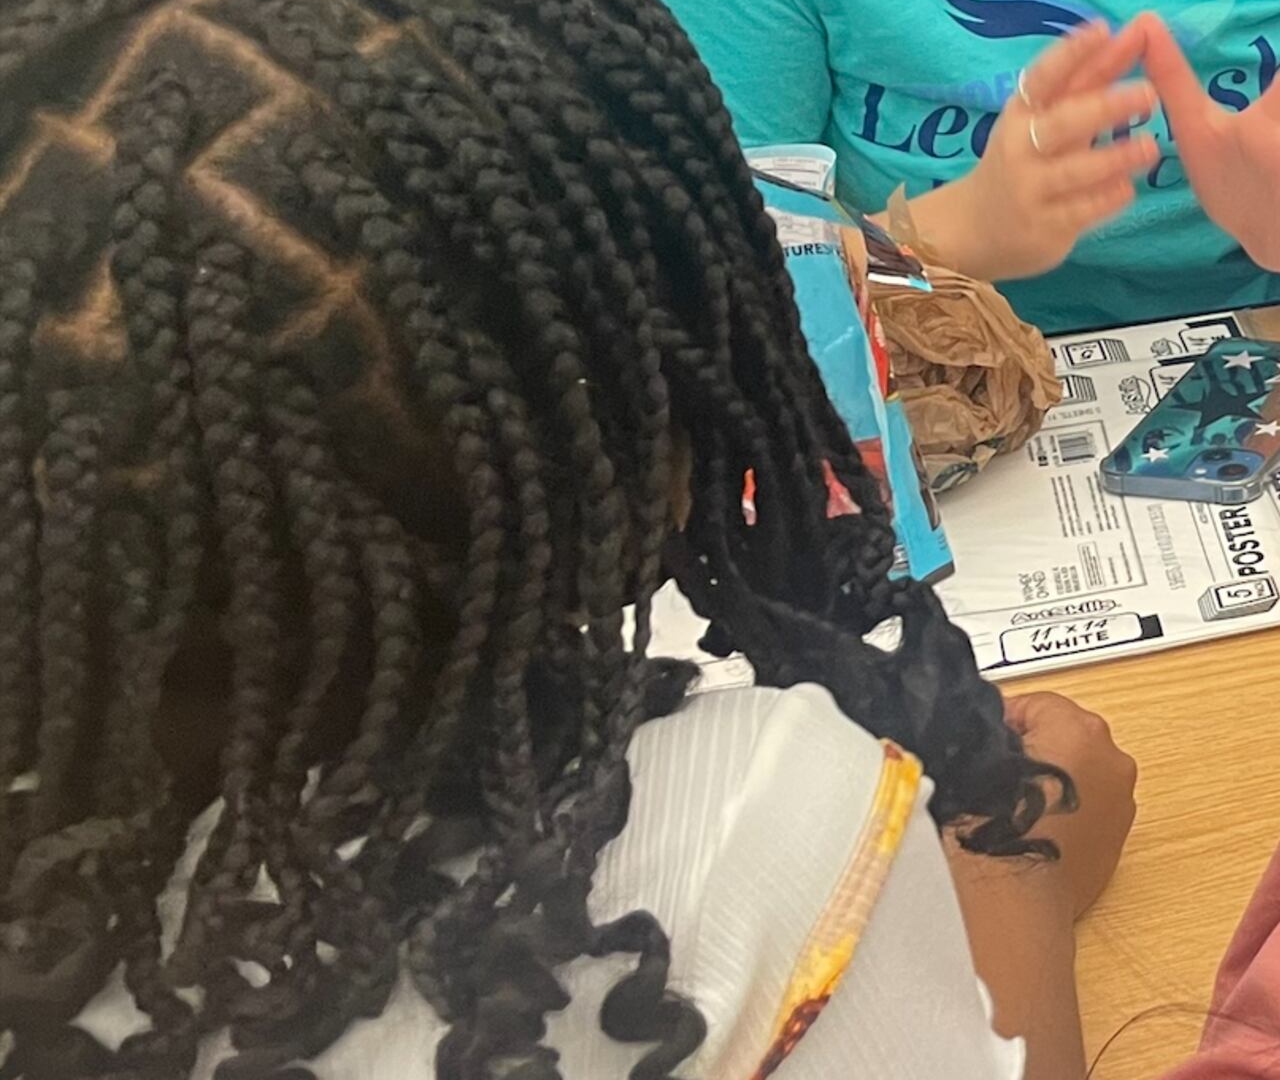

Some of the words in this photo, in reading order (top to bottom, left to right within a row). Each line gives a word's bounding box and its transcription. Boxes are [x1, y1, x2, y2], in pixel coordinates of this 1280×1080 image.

[1218, 505, 1270, 577] POSTER
[1227, 588, 1252, 599] 5
[1031, 629, 1110, 652] WHITE
